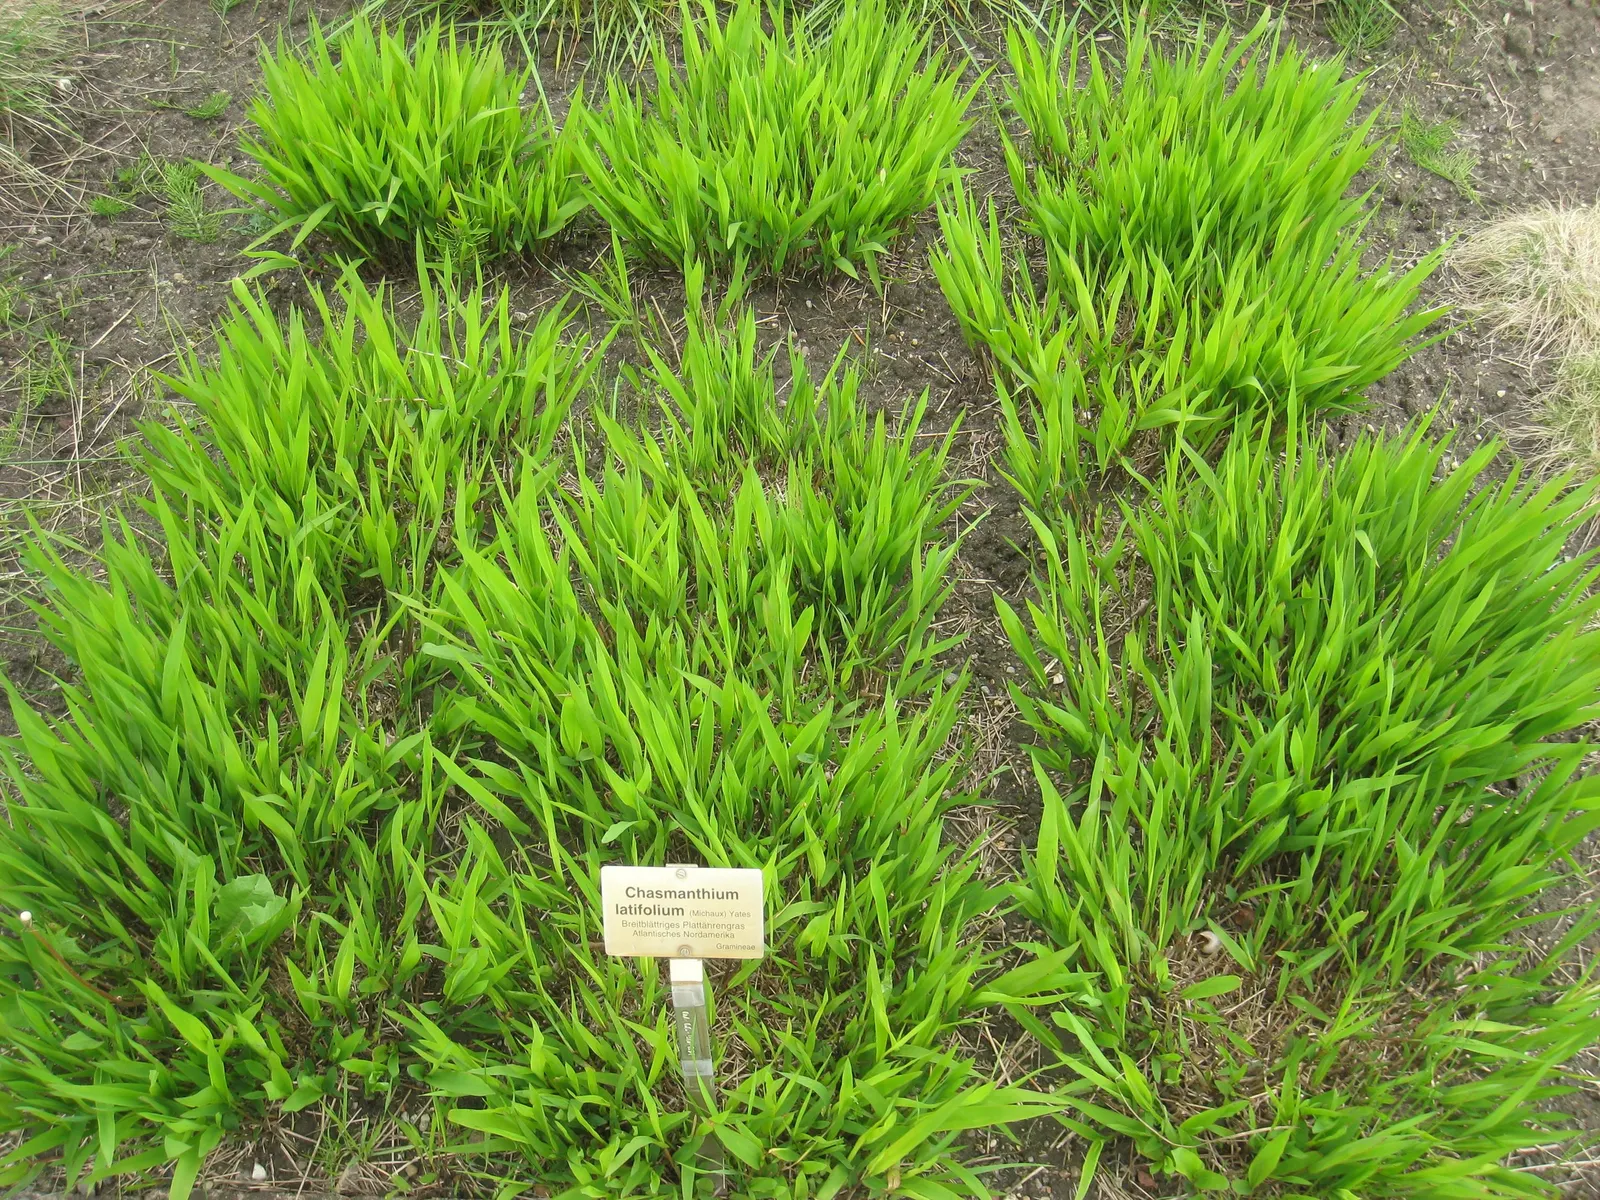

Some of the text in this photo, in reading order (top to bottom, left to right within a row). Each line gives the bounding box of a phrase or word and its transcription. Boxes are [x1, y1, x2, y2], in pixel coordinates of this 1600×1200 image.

[625, 886, 739, 900] Chasmanthium
[615, 903, 685, 916] latifolium
[689, 909, 727, 919] (Michaux)
[621, 919, 745, 931] Breitblättriges Plattährengras
[632, 930, 735, 939] Atlantisches Nordamerika
[716, 943, 756, 951] Gramineae
